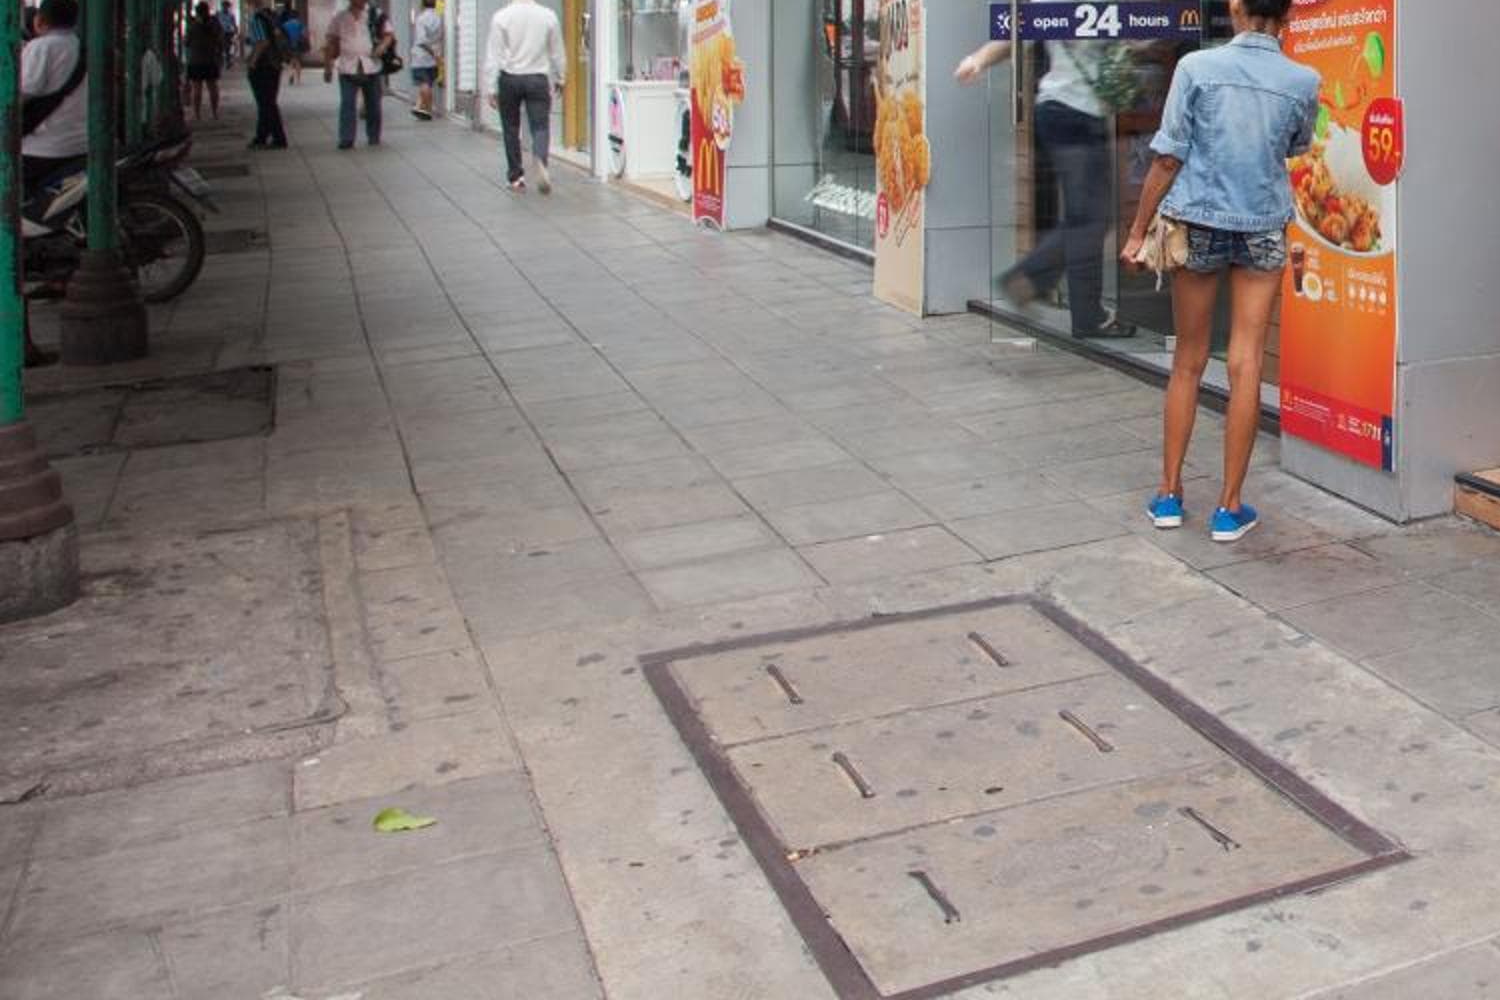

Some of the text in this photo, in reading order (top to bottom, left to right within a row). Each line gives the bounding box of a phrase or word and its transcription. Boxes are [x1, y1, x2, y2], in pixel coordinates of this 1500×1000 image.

[1033, 15, 1069, 34] open
[1075, 3, 1122, 37] 24
[1129, 14, 1169, 28] hours
